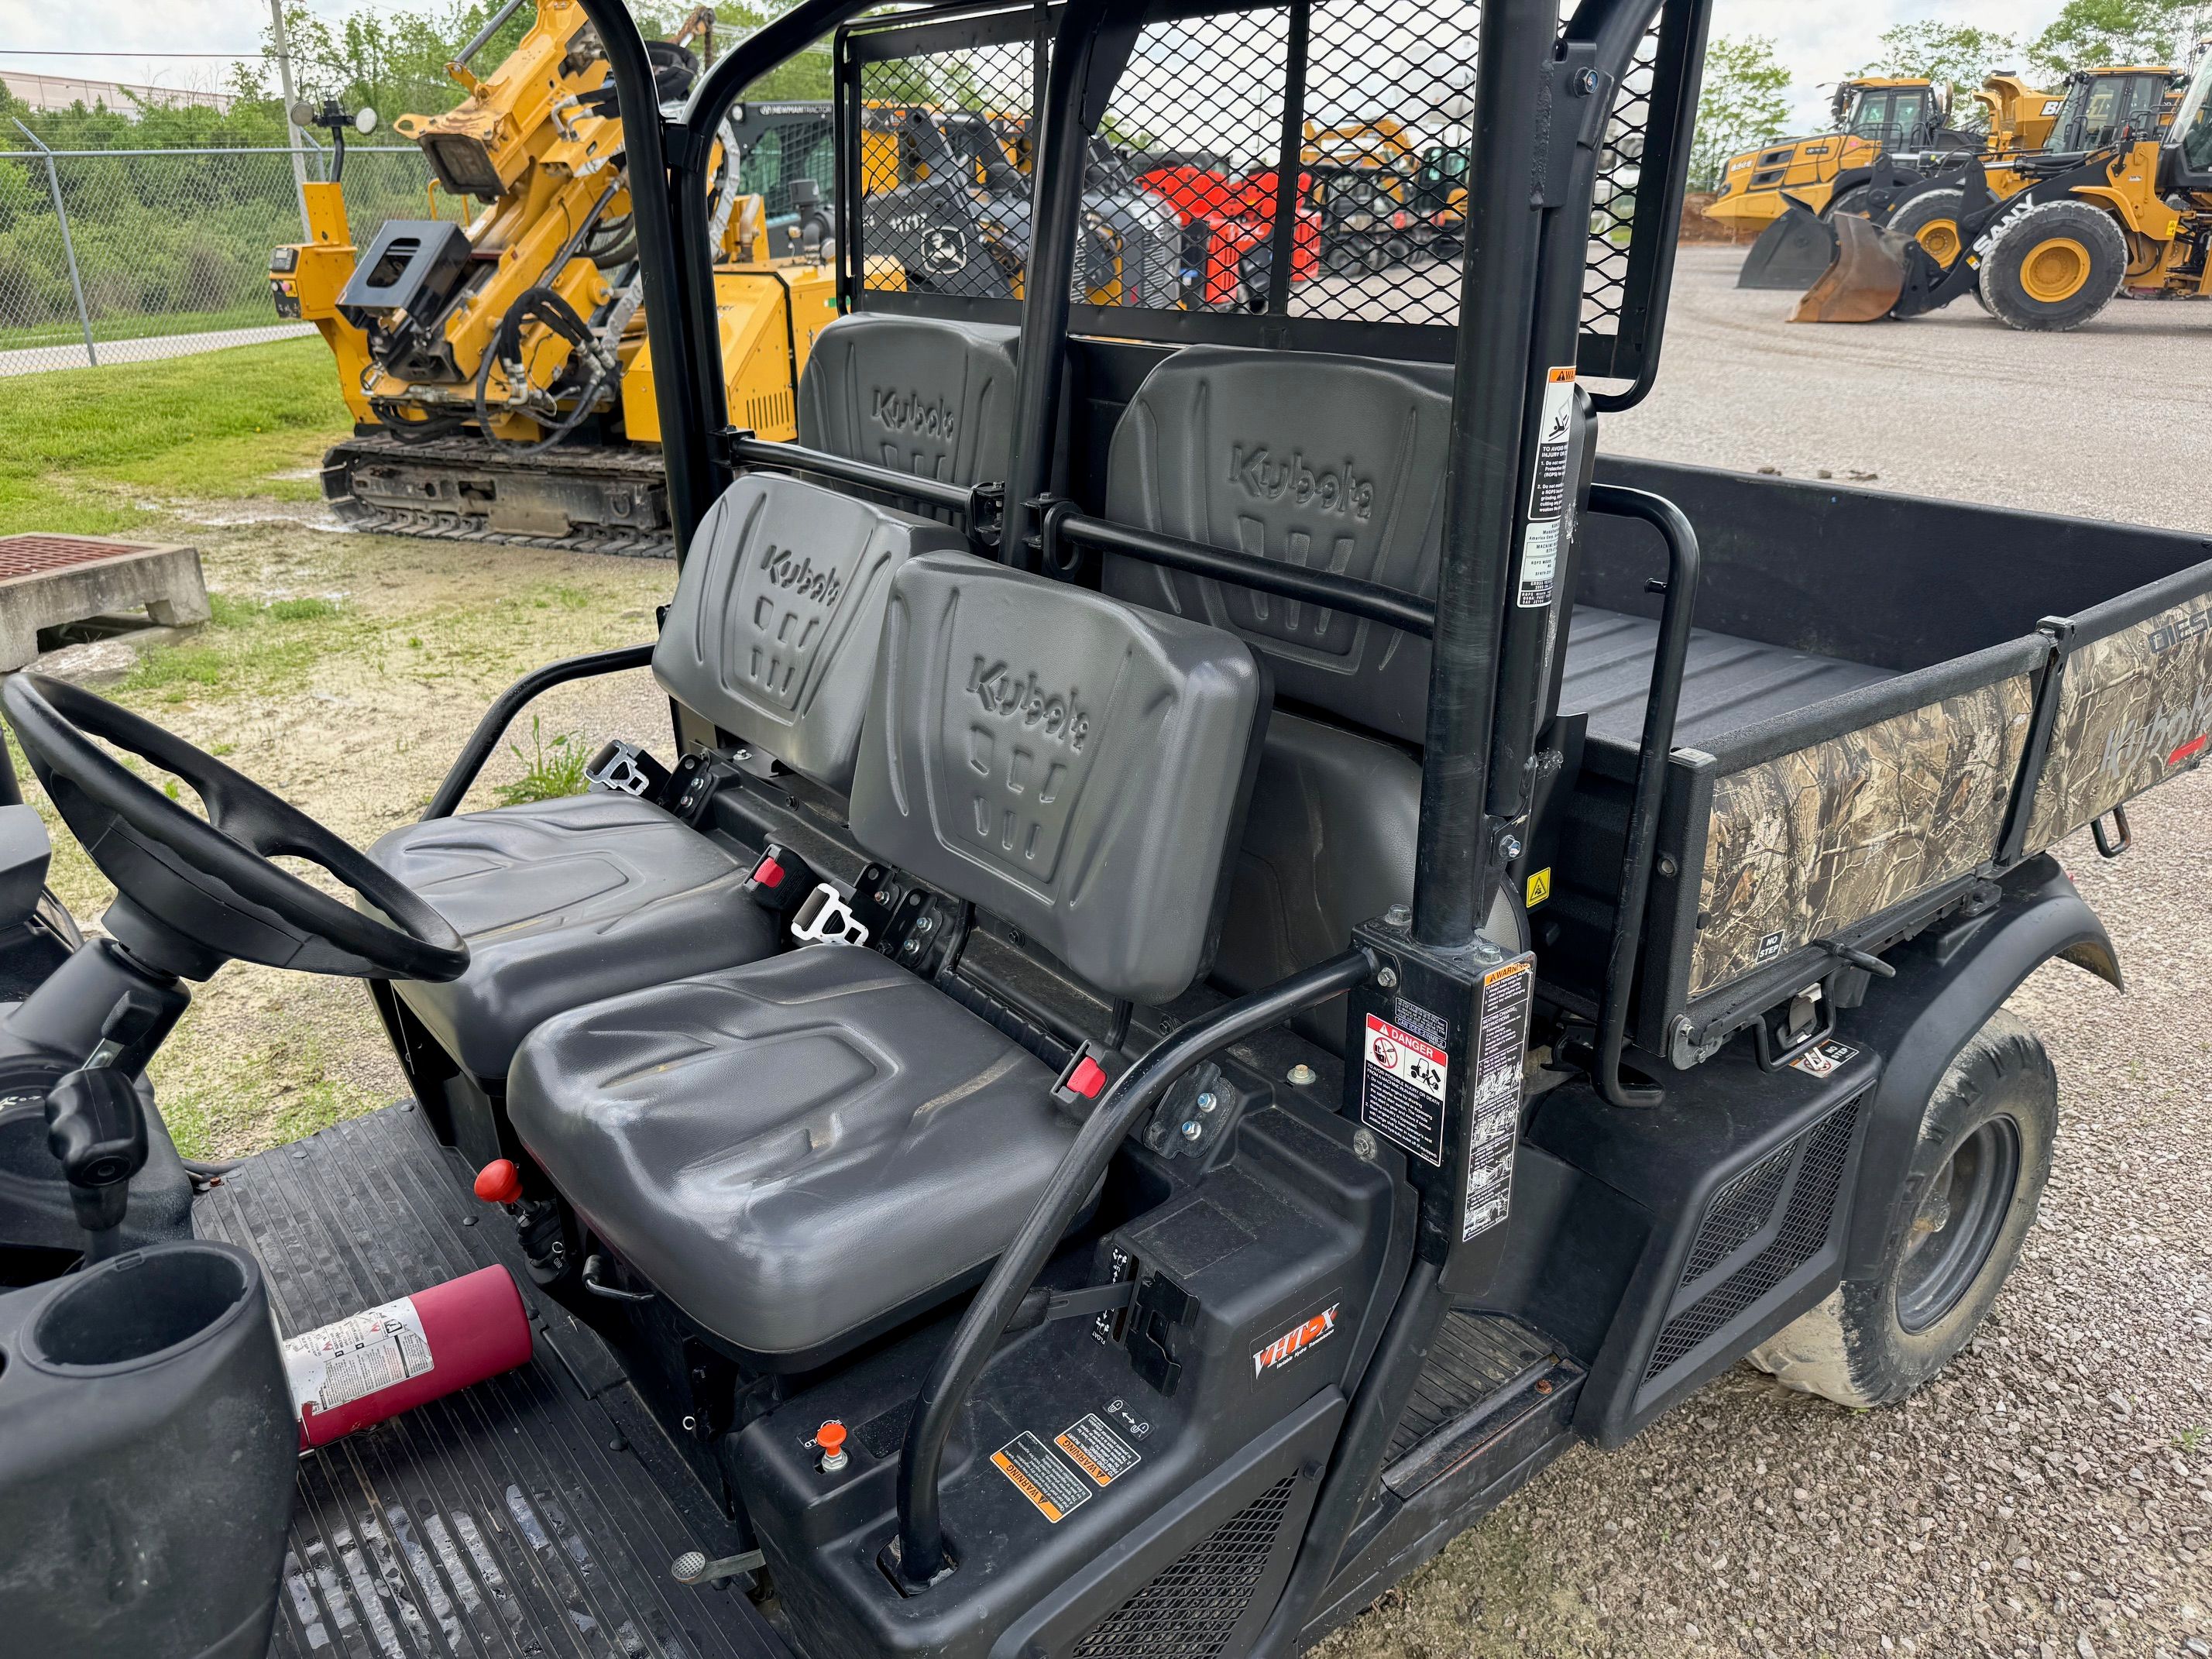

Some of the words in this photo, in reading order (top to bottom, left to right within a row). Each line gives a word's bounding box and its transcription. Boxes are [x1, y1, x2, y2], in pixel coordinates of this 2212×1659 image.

[1229, 445, 1373, 519] Kubota
[761, 545, 840, 606] Kubota
[967, 656, 1089, 751] Kubota
[1766, 936, 1778, 946] NO
[1759, 944, 1779, 958] STEP
[1391, 1029, 1433, 1058] DANGER
[1831, 1047, 1849, 1060] STEP
[1367, 1068, 1378, 1077] FROM
[1373, 1066, 1384, 1075] AVOID
[1405, 1084, 1418, 1094] INJURY
[1426, 1095, 1440, 1105] DEATH
[1391, 1088, 1402, 1097] engine
[1092, 1331, 1106, 1345] FLOAT
[1253, 1302, 1340, 1379] VHT-X
[1276, 1356, 1293, 1369] Variable
[1294, 1347, 1307, 1358] Hydro
[1309, 1328, 1334, 1348] Transmission
[1066, 1433, 1080, 1444] INJURY
[1061, 1439, 1098, 1473] WARNING
[1080, 1443, 1098, 1462] PERSONAL
[1089, 1445, 1108, 1464] CRUSHING:
[1097, 1461, 1109, 1472] AVOID
[1107, 1463, 1119, 1474] FROM
[1005, 1463, 1040, 1498] WARNING
